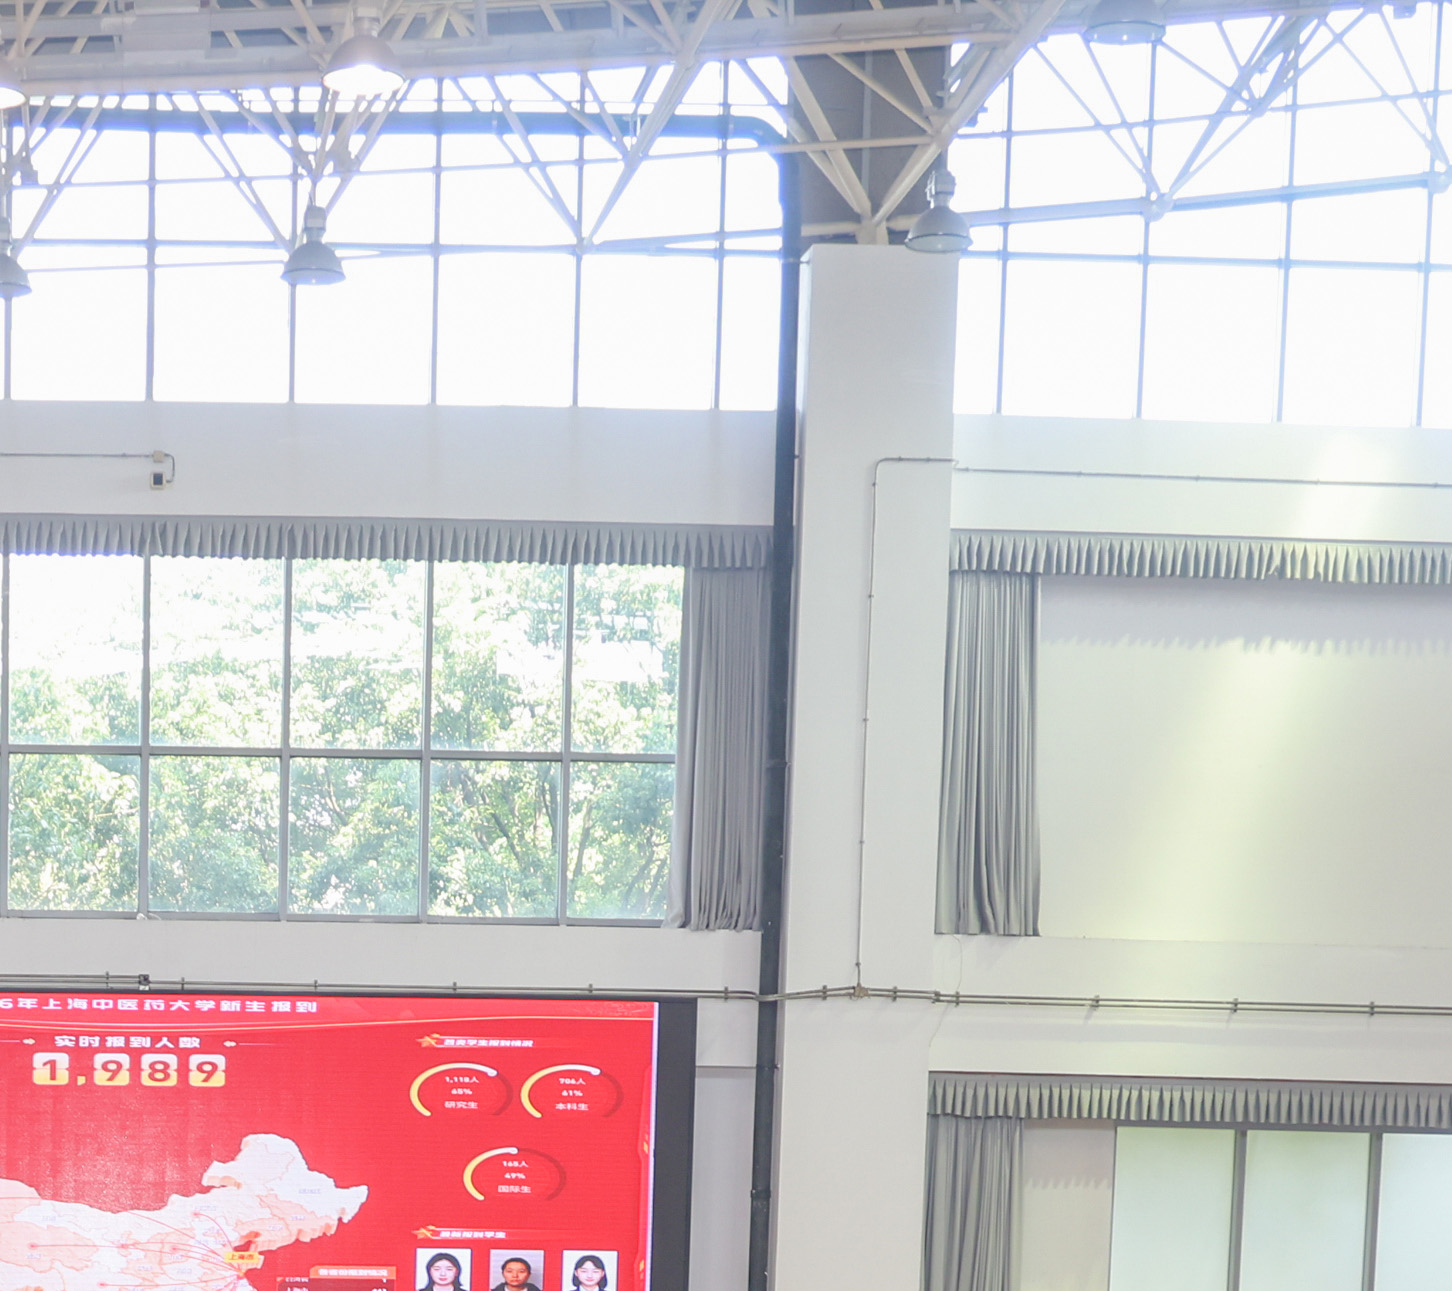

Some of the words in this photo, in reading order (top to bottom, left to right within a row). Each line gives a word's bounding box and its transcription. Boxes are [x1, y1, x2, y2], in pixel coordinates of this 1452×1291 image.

[54, 1035, 201, 1049] 实时报到人数
[42, 1059, 218, 1086] 1,989
[444, 1101, 478, 1109] 研究生
[555, 1103, 589, 1111] 本科生
